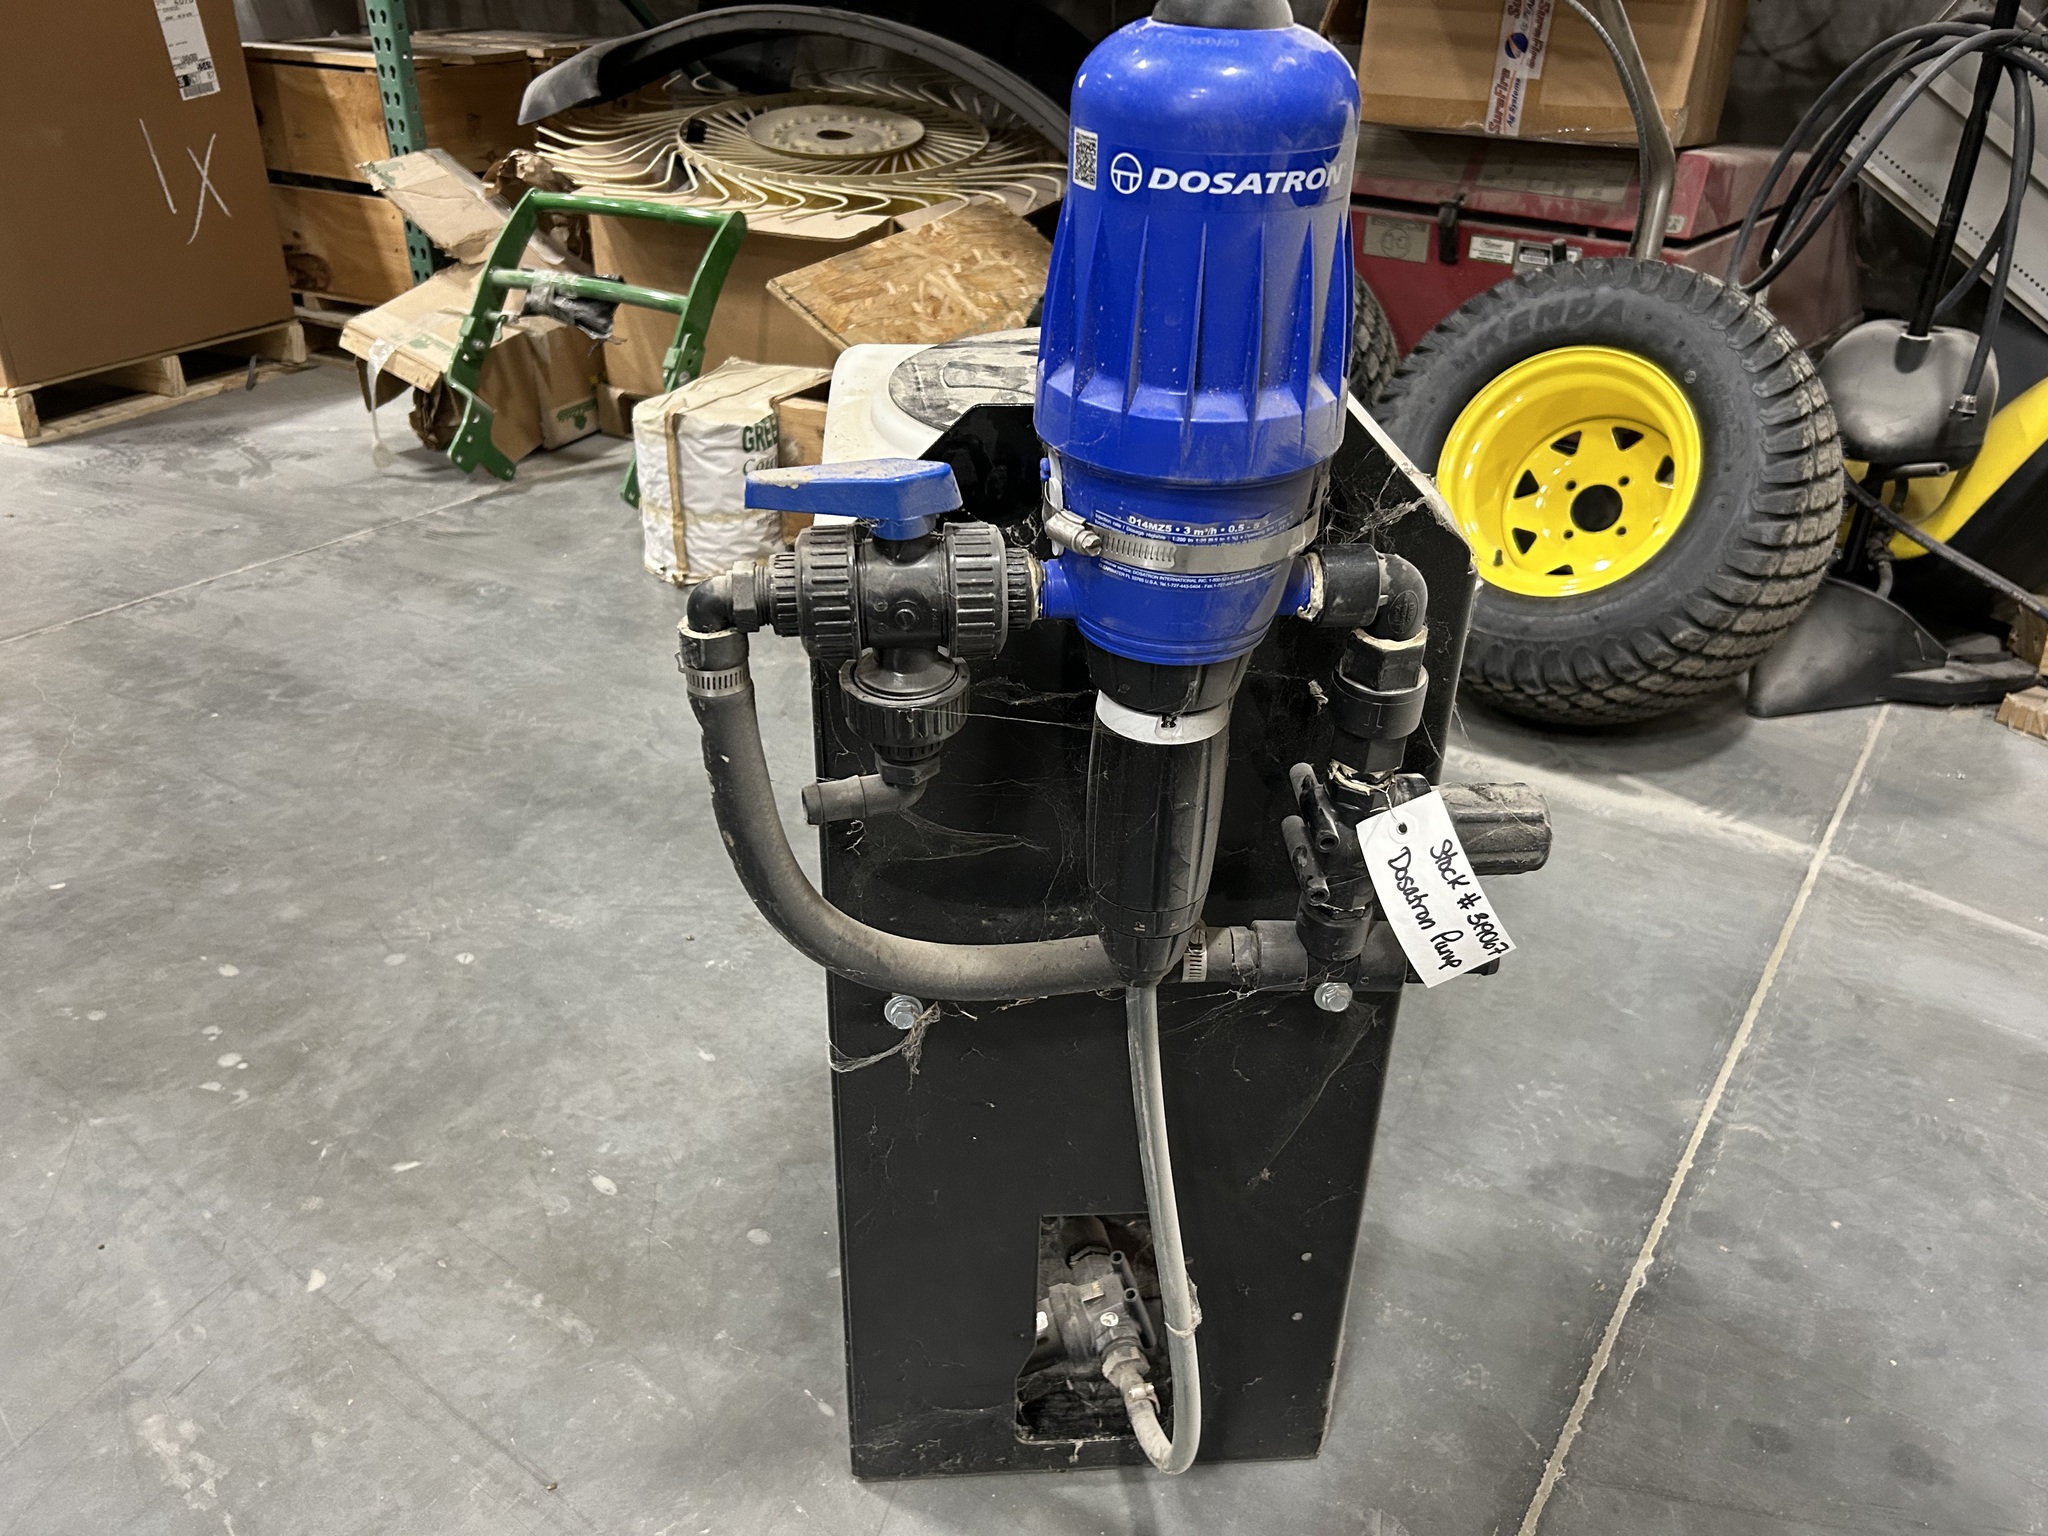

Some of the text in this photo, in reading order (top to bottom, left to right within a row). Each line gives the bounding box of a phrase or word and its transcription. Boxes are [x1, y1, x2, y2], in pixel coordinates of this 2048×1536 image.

[1147, 165, 1344, 195] DOSATRON
[1473, 296, 1628, 357] KENDA
[1129, 515, 1172, 533] D14MZ5
[1183, 526, 1191, 535] 3
[1228, 524, 1245, 533] 0.5
[1388, 846, 1464, 970] Dosatron Pump
[1430, 839, 1509, 955] Stock # 319067
